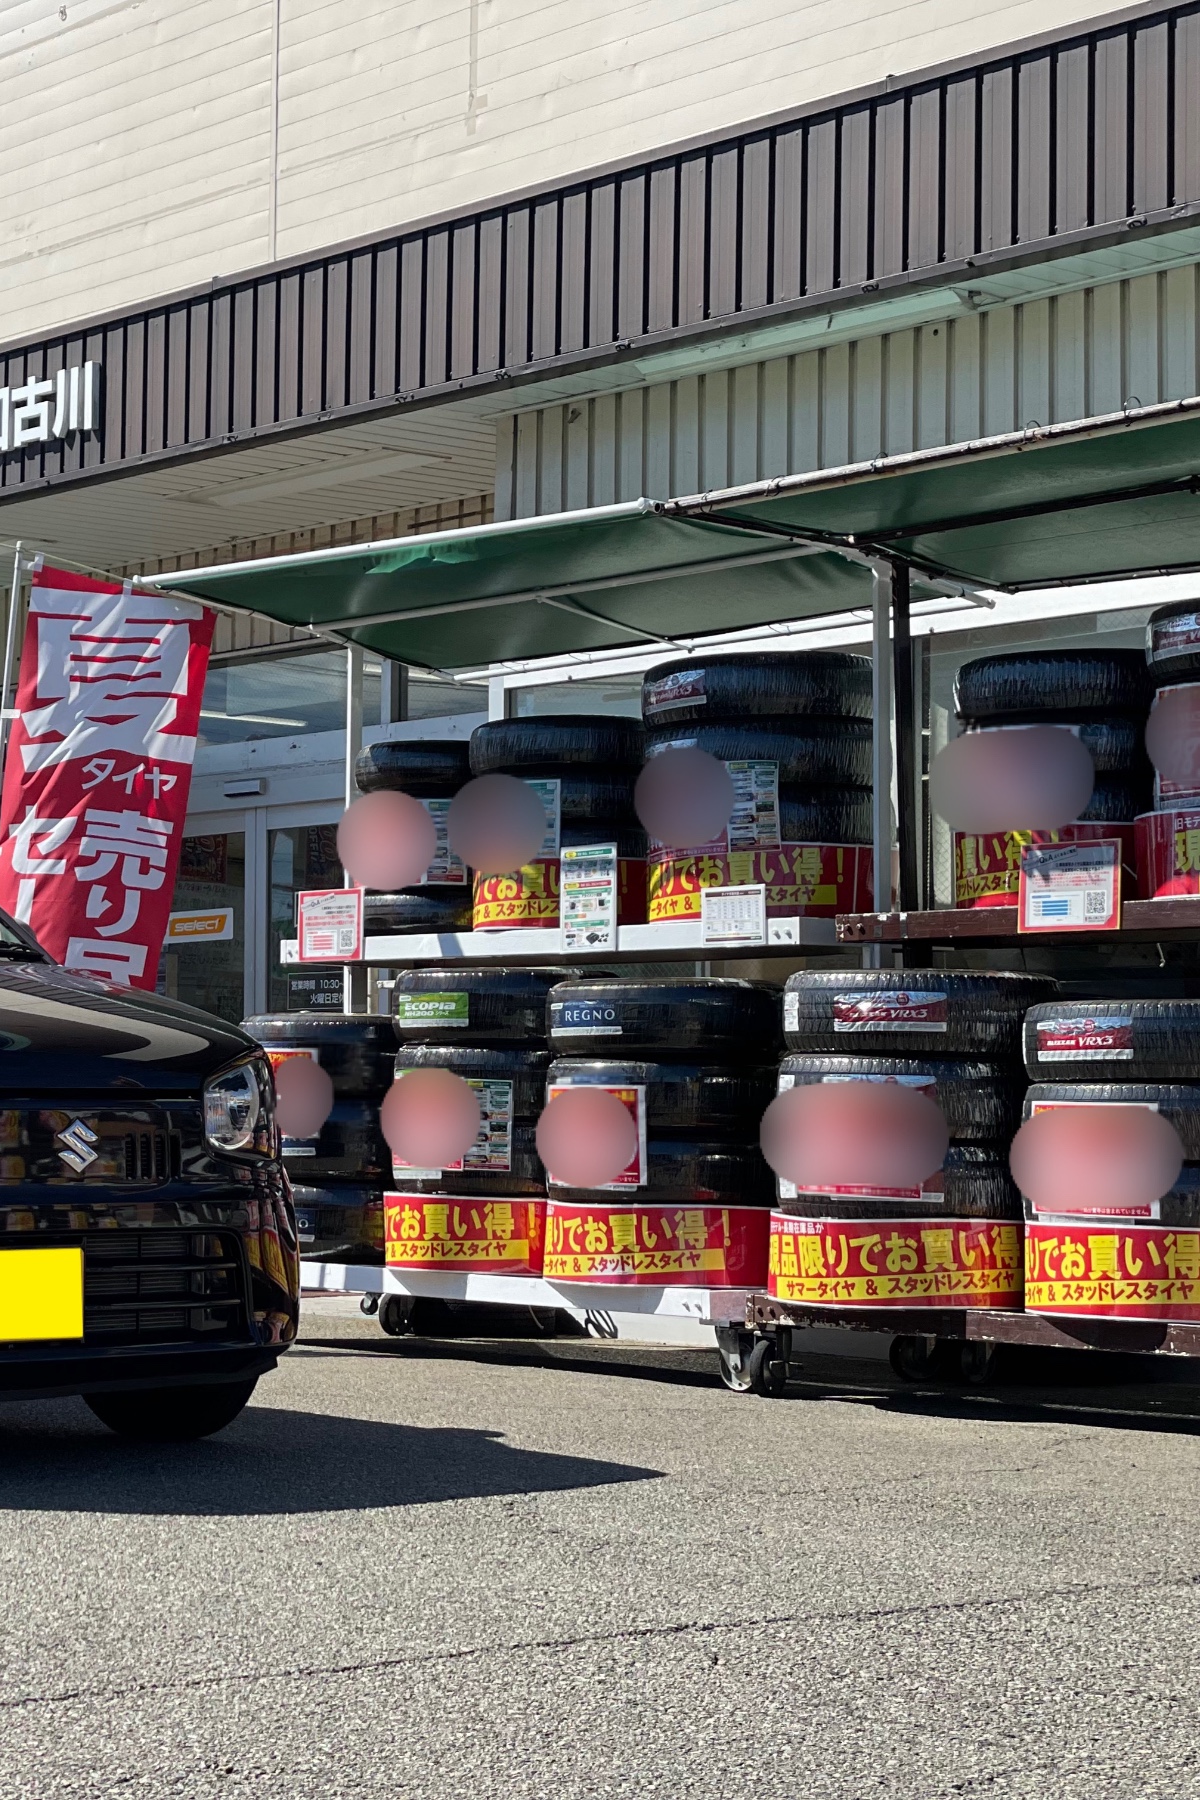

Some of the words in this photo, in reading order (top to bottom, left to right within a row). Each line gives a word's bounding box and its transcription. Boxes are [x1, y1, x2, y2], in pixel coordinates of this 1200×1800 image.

[20, 586, 204, 773] 夏
[81, 757, 178, 800] タイヤ
[483, 904, 491, 919] &
[684, 896, 693, 910] &
[565, 1009, 615, 1022] REGNO
[890, 1009, 928, 1018] VRX3
[1078, 1035, 1113, 1047] VRX3
[400, 1241, 508, 1258] スタッドレスタイヤ
[573, 1258, 582, 1273] &
[587, 1251, 701, 1272] スタッドレスタイヤ
[786, 1280, 856, 1299] サマータイヤ
[866, 1278, 879, 1296] &
[888, 1272, 1015, 1295] スタッドレスタイヤ
[1047, 1285, 1056, 1302] &
[1062, 1281, 1195, 1301] スタッドレスタイヤ
